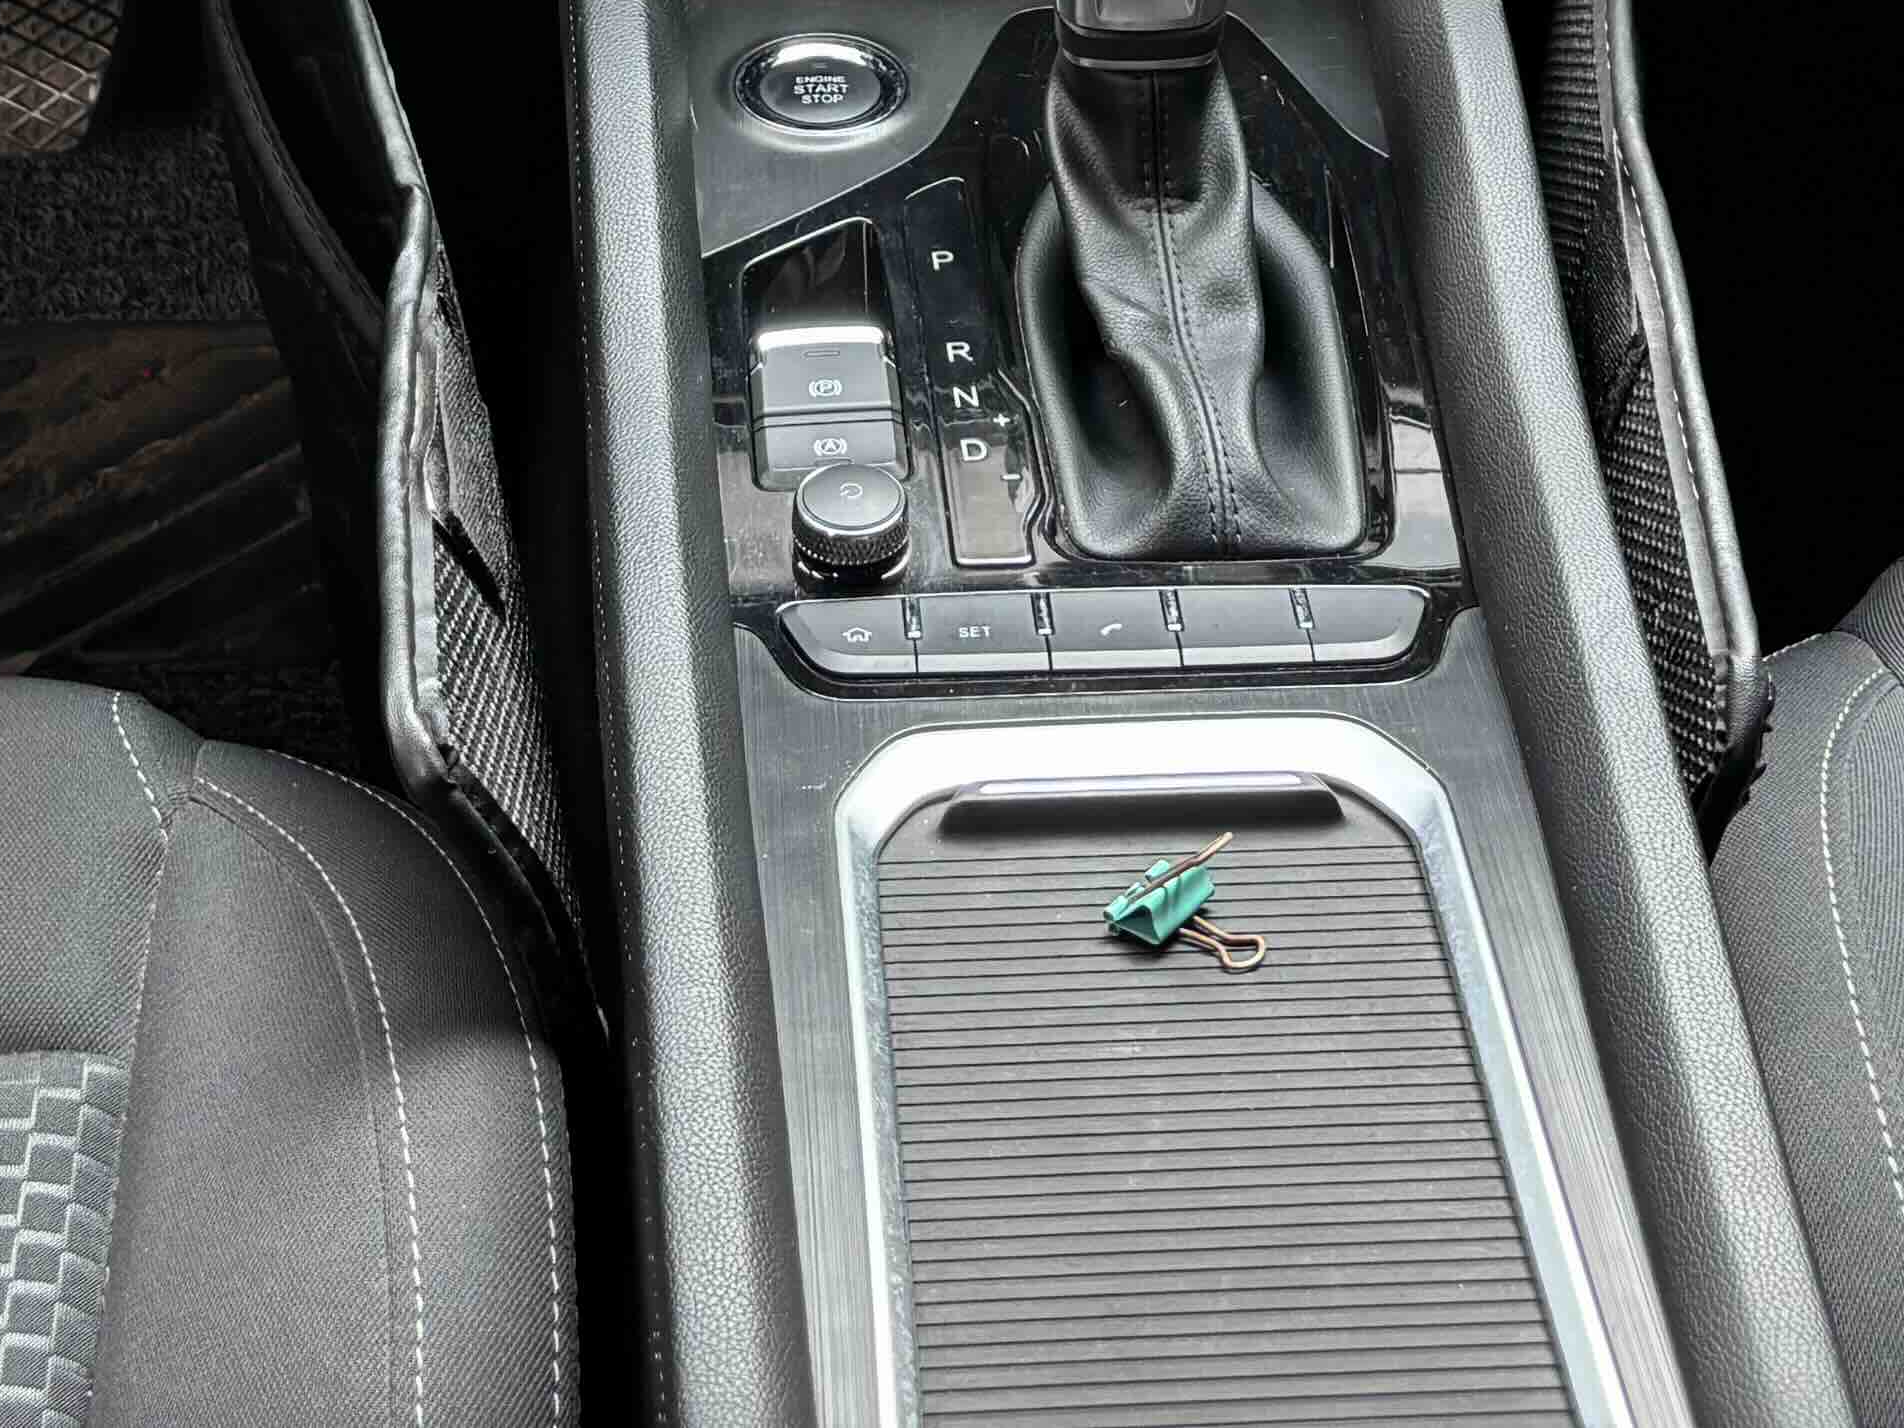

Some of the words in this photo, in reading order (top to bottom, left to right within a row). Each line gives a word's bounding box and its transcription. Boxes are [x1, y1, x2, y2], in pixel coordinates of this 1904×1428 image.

[796, 75, 846, 84] ENGINE
[794, 84, 848, 94] START
[801, 94, 843, 104] STOP
[931, 250, 955, 271] P
[946, 342, 974, 363] R
[953, 385, 980, 408] N
[959, 439, 988, 462] D
[959, 626, 991, 638] SET
